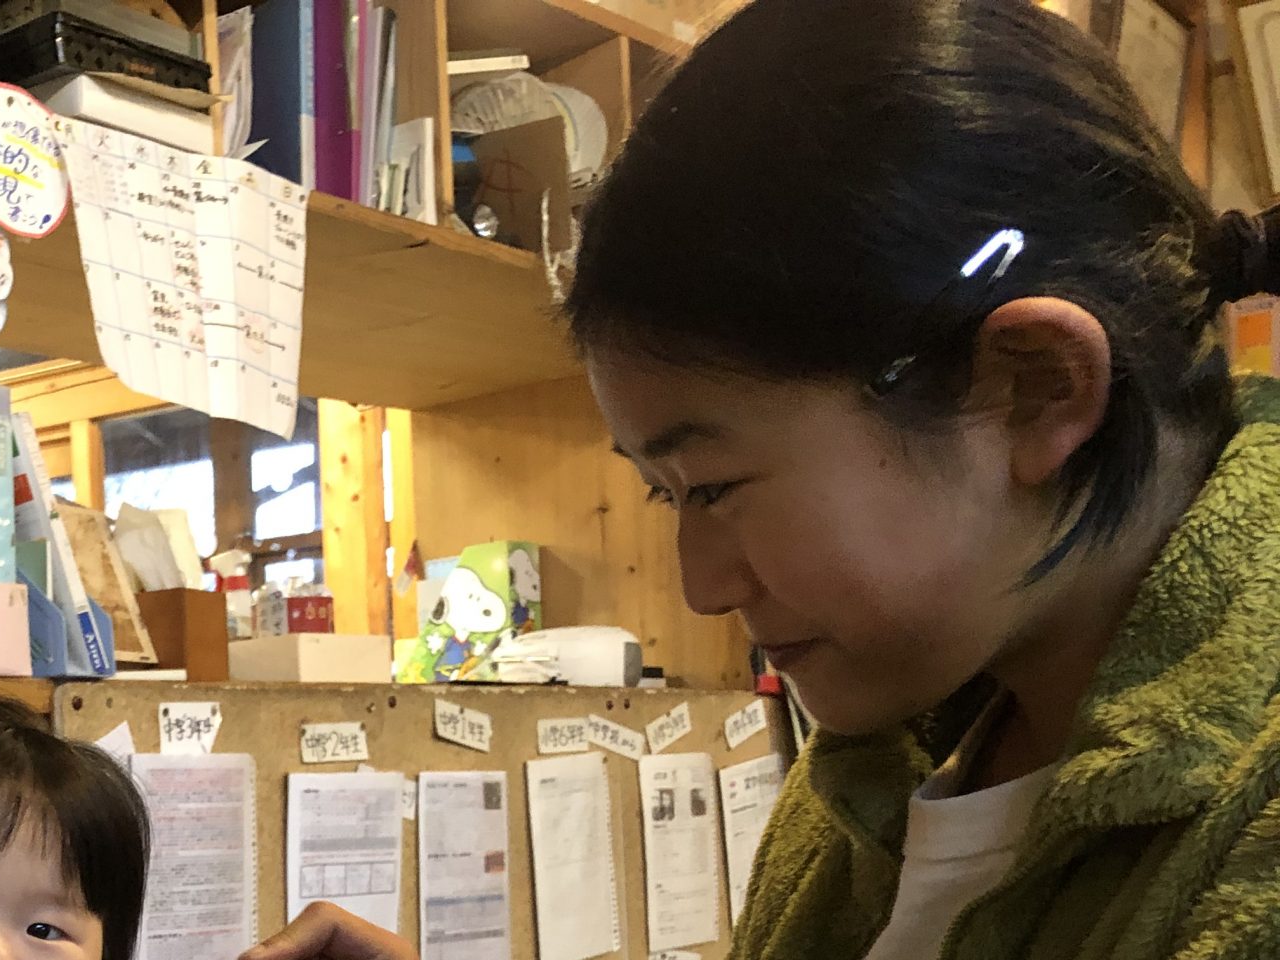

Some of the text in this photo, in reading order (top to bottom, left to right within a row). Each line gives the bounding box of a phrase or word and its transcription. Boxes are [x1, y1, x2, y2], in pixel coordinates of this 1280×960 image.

[163, 714, 214, 742] 中学3年生
[305, 729, 362, 759] 中学2年生
